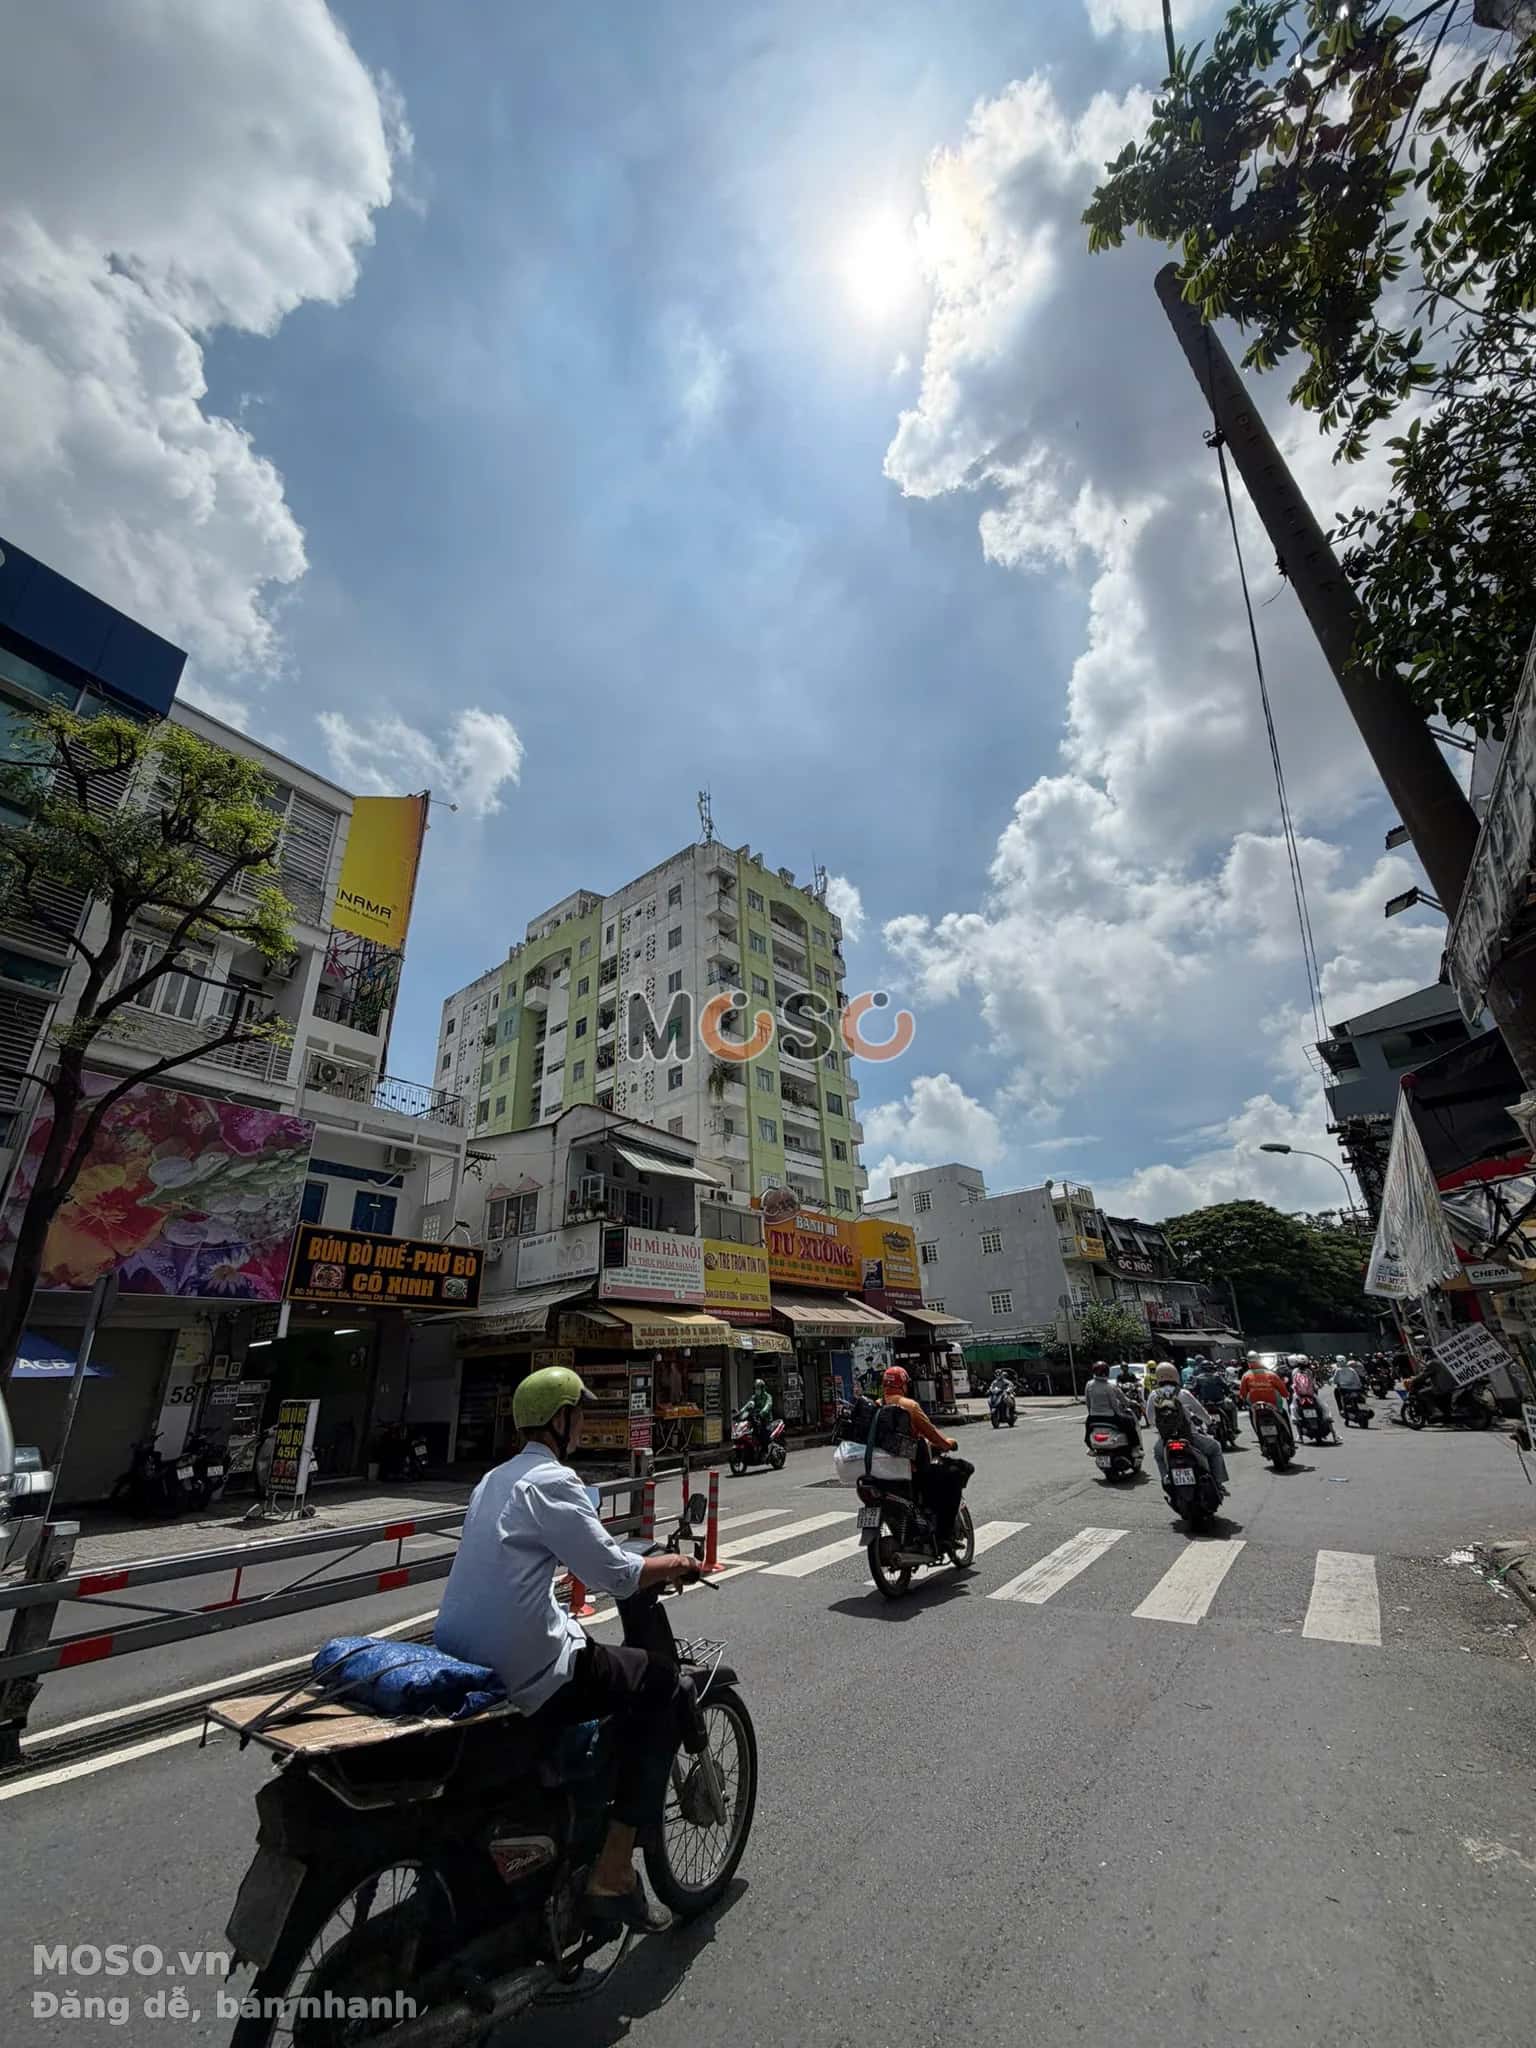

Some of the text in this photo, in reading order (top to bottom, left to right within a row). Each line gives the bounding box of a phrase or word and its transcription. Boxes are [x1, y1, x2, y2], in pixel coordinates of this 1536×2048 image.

[308, 1234, 347, 1263] BÚN
[348, 1239, 373, 1266] BÒ
[452, 1252, 477, 1277] BÒ
[662, 1238, 679, 1256] HÀ
[680, 1241, 701, 1260] NỘI
[352, 1270, 435, 1297] CÔ XINH
[18, 1358, 71, 1371] ACB
[170, 1385, 196, 1404] 58
